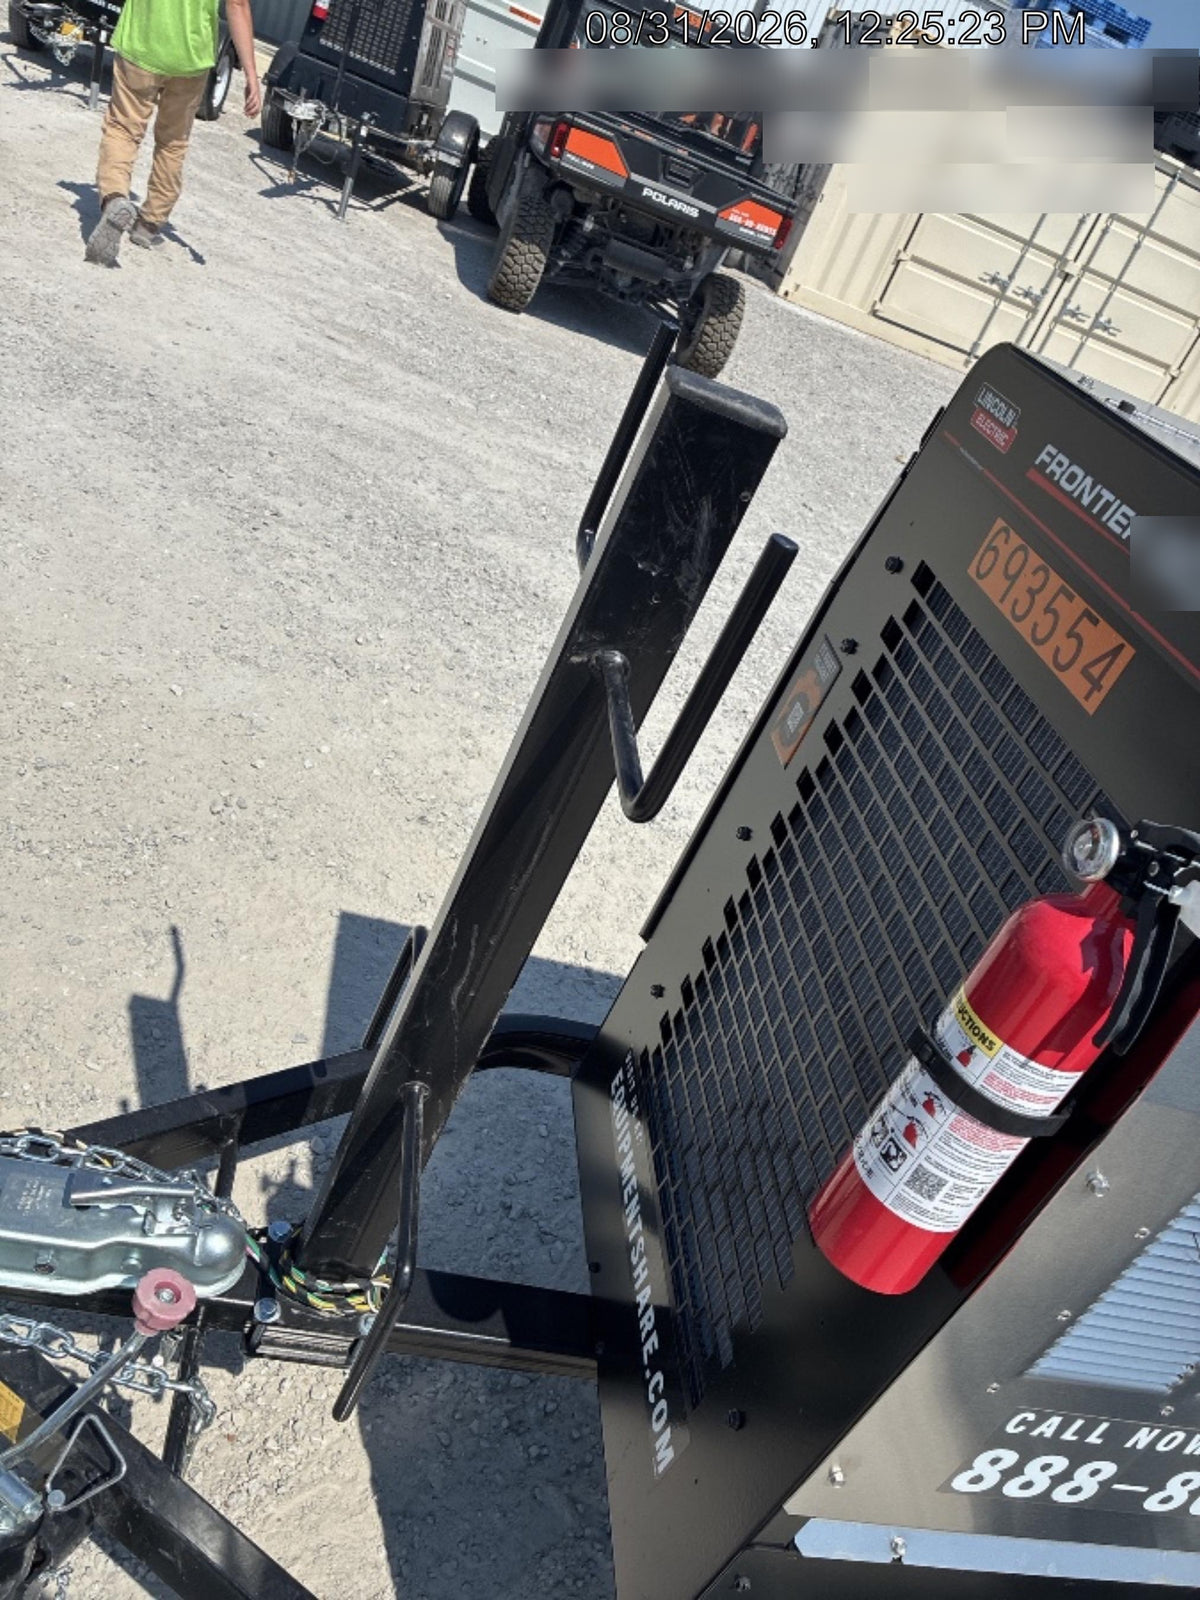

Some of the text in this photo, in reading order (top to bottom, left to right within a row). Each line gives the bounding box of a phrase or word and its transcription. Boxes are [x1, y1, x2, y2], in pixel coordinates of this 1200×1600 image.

[641, 187, 700, 219] POLARIS
[976, 386, 1017, 428] LINCOLN
[974, 412, 1009, 448] ELECTRIC
[974, 524, 1126, 703] 693554
[611, 1067, 677, 1476] EQUIPMENTSHARE.COM
[1005, 1411, 1111, 1445] CALL
[950, 1447, 1200, 1517] 888-8
